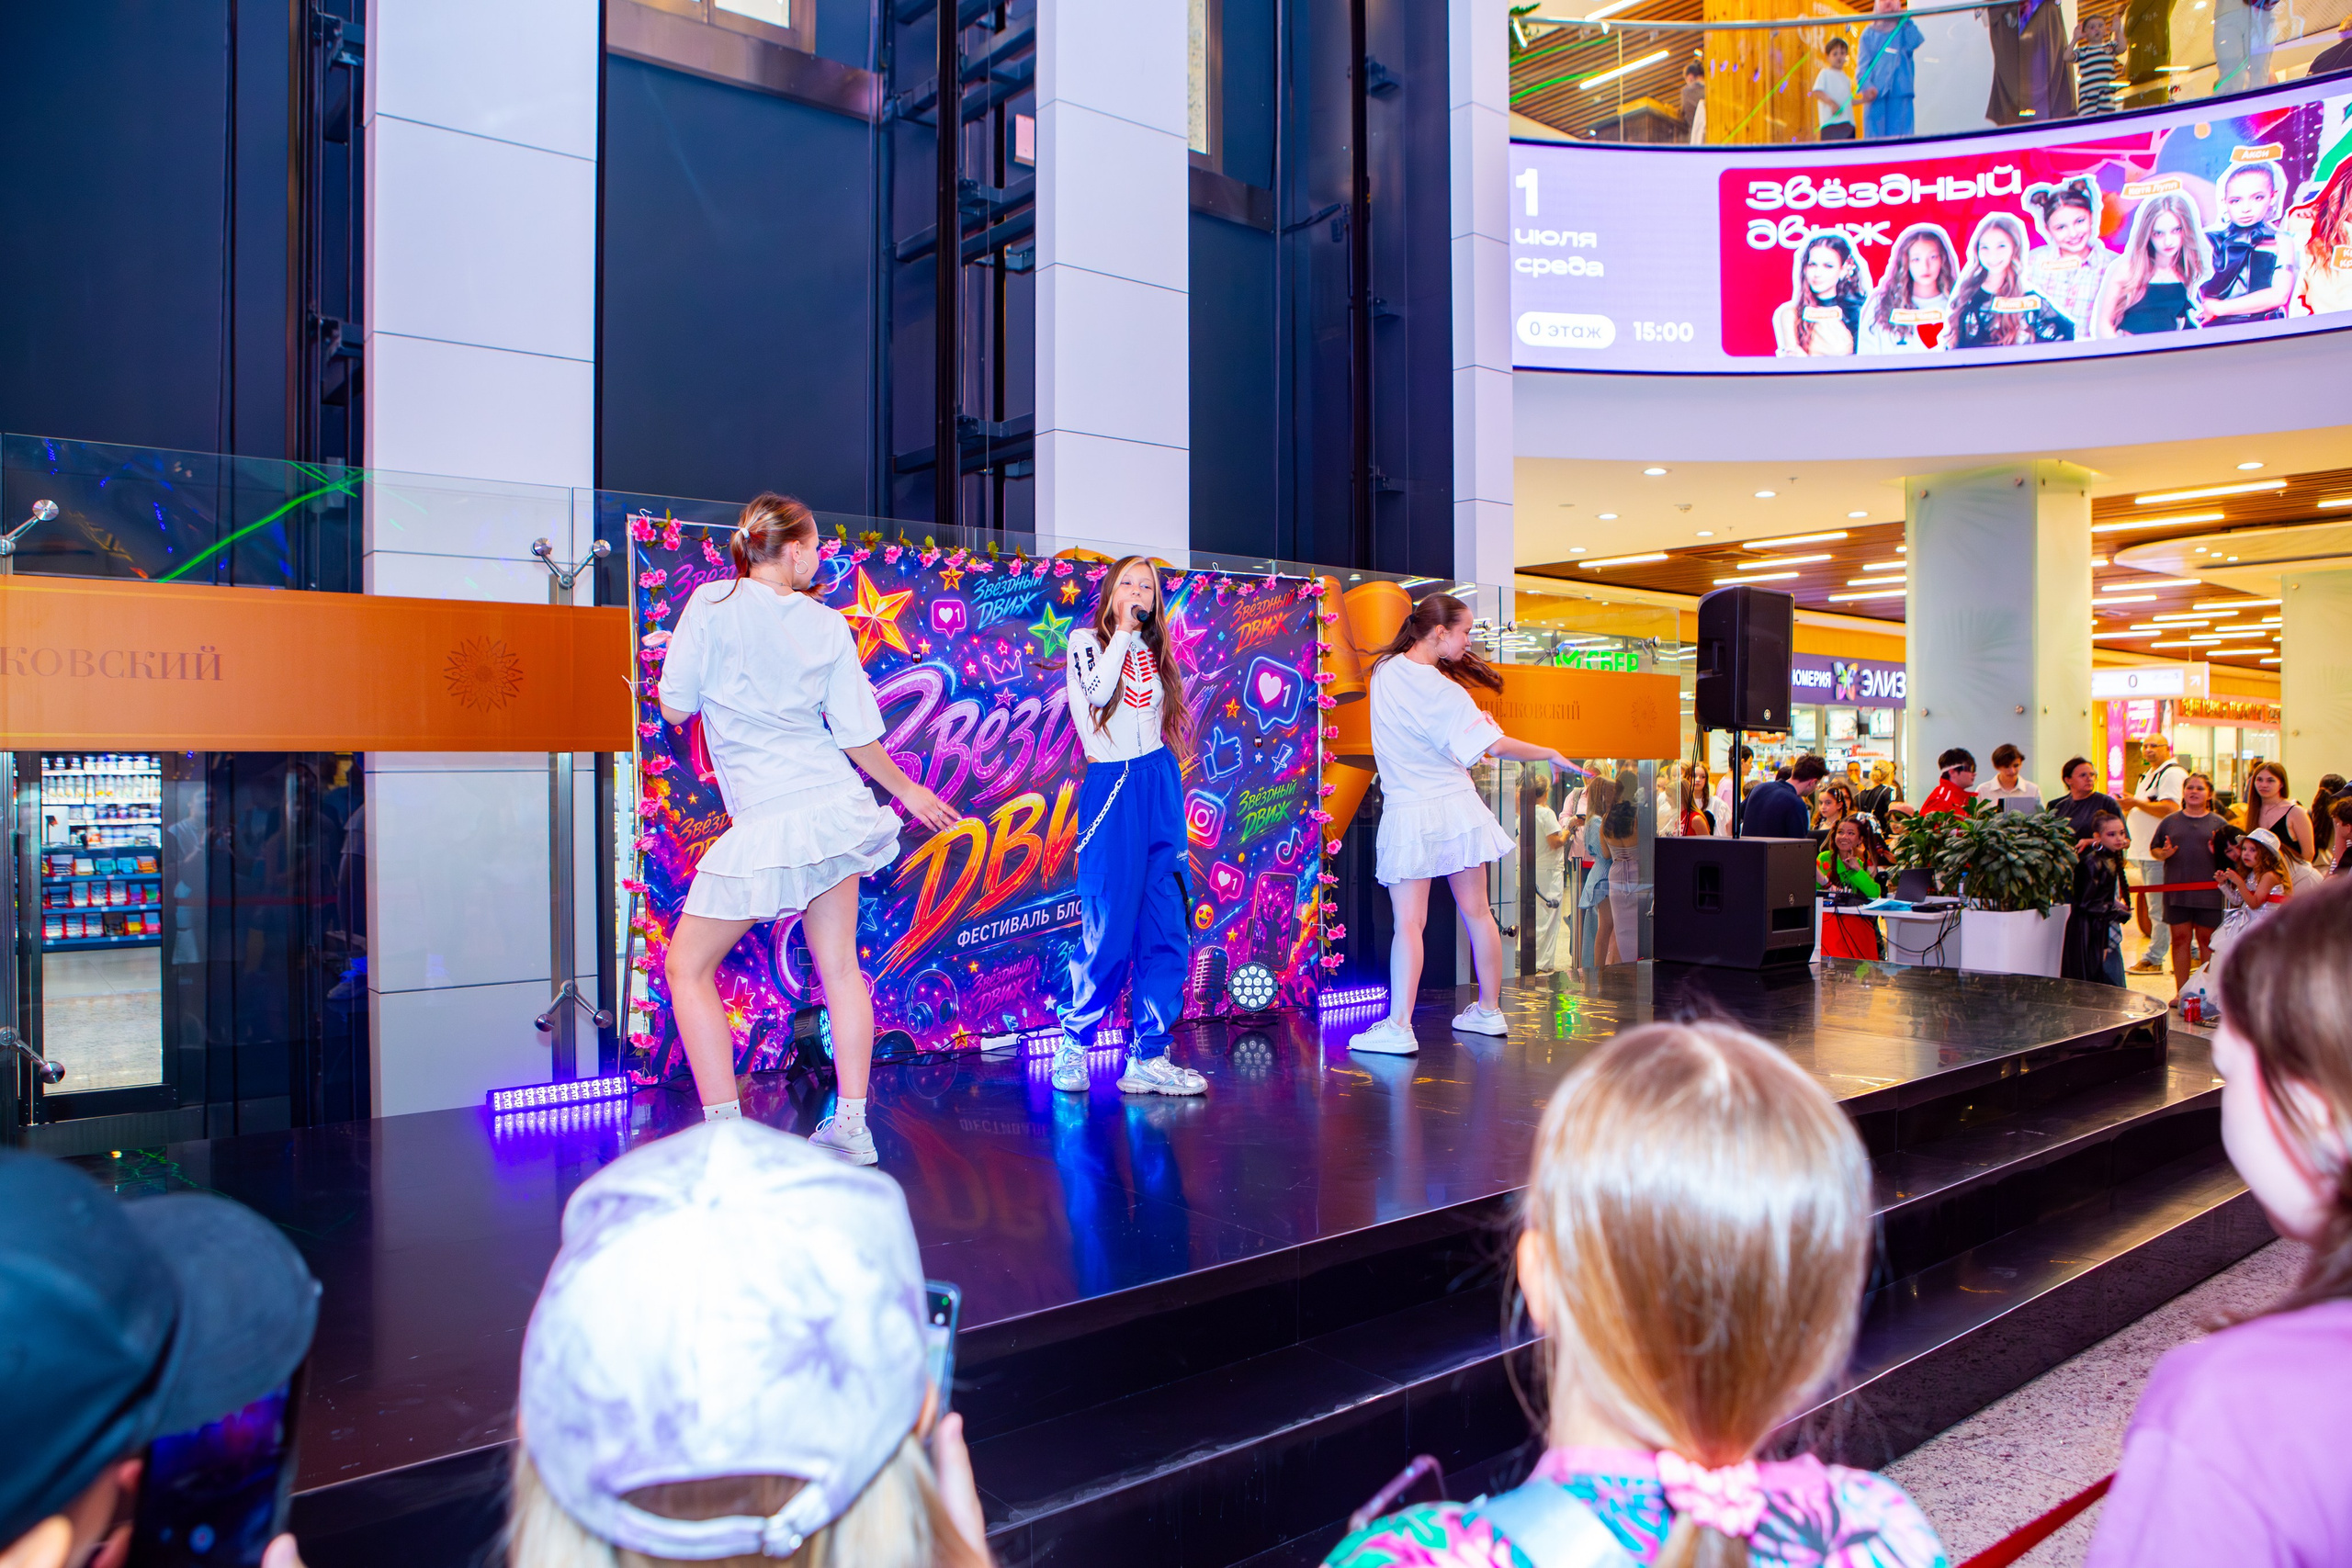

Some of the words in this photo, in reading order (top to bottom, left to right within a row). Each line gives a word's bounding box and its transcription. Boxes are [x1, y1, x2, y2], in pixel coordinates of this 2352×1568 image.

[1515, 168, 1539, 217] 1
[1745, 164, 2022, 210] звёздный
[1514, 228, 1598, 248] июля
[1514, 255, 1604, 278] среда
[1530, 321, 1541, 336] 0
[1547, 324, 1602, 339] этаж
[1633, 321, 1694, 343] 15:00
[955, 607, 961, 623] 1
[1283, 683, 1292, 707] 1
[1861, 669, 1907, 699] ЭЛИЗ
[956, 908, 1050, 948] ФЕСТИВАЛЬ
